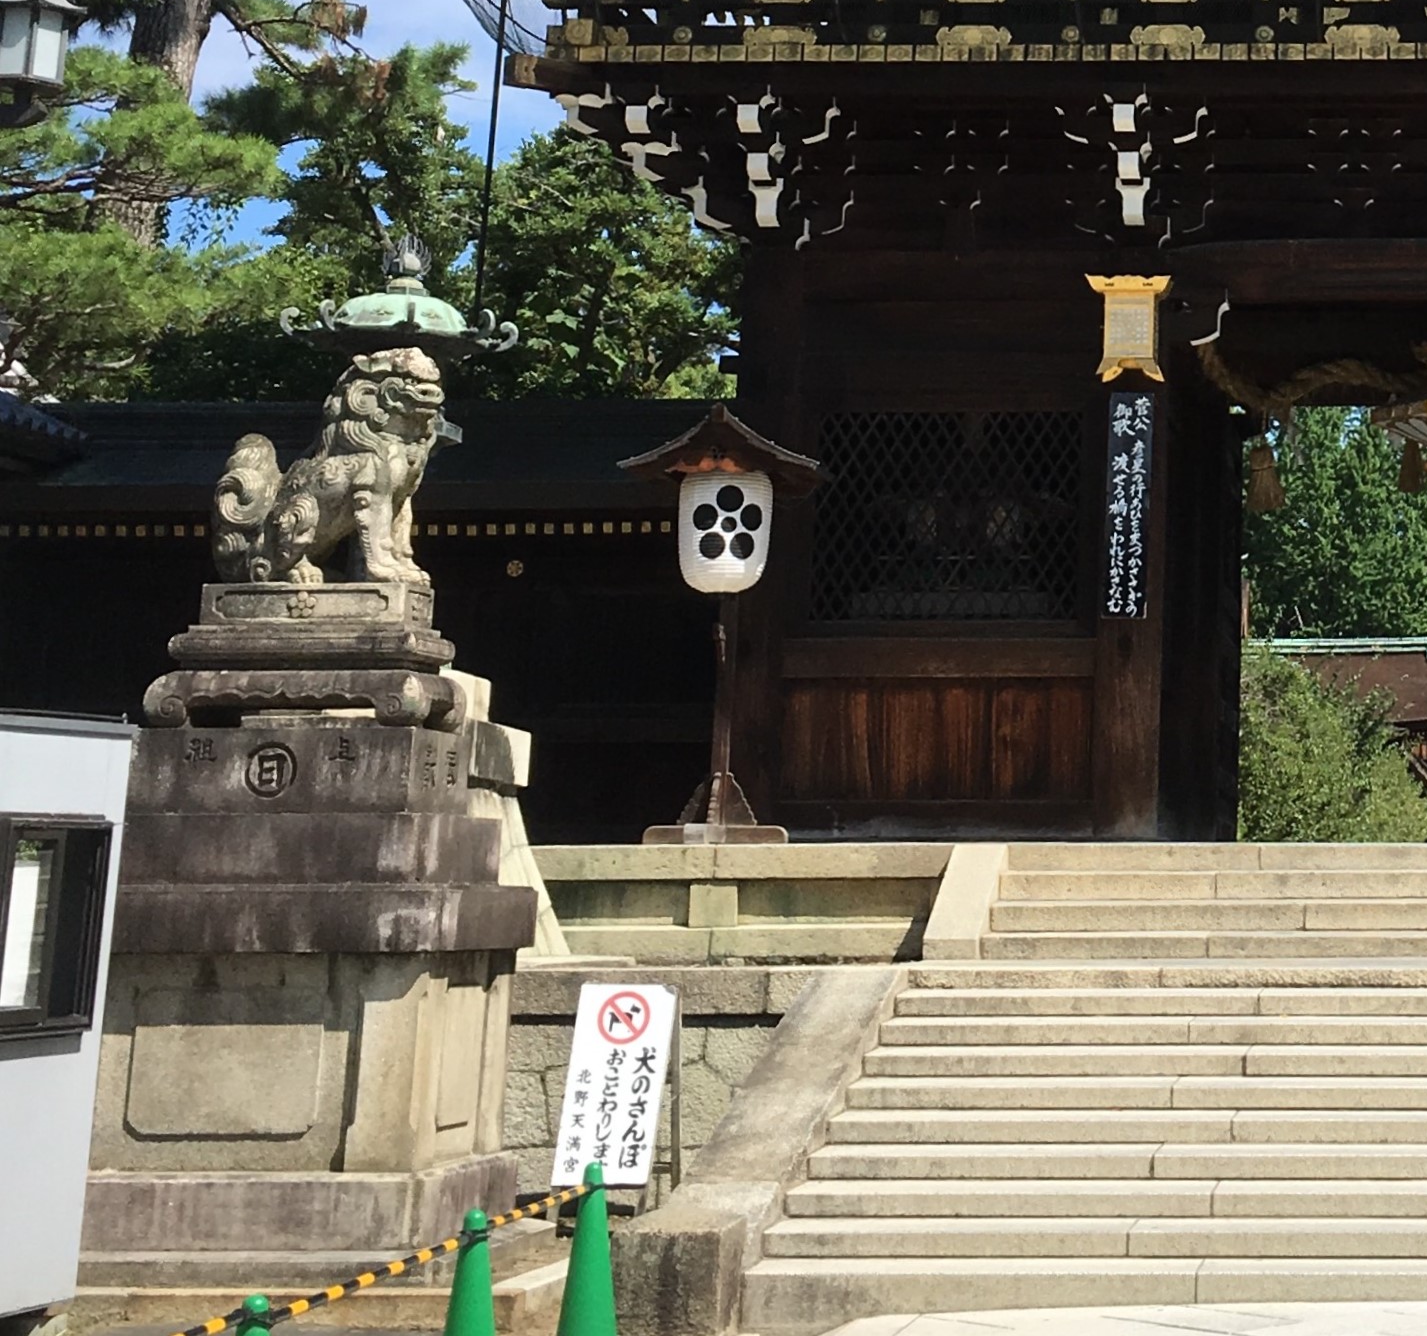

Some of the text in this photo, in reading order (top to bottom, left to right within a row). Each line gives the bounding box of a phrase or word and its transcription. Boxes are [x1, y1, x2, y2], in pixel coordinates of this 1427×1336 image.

[1112, 403, 1135, 437] 御歌
[563, 1068, 592, 1173] 北野天満宮
[618, 1046, 657, 1169] 犬のさんぽ
